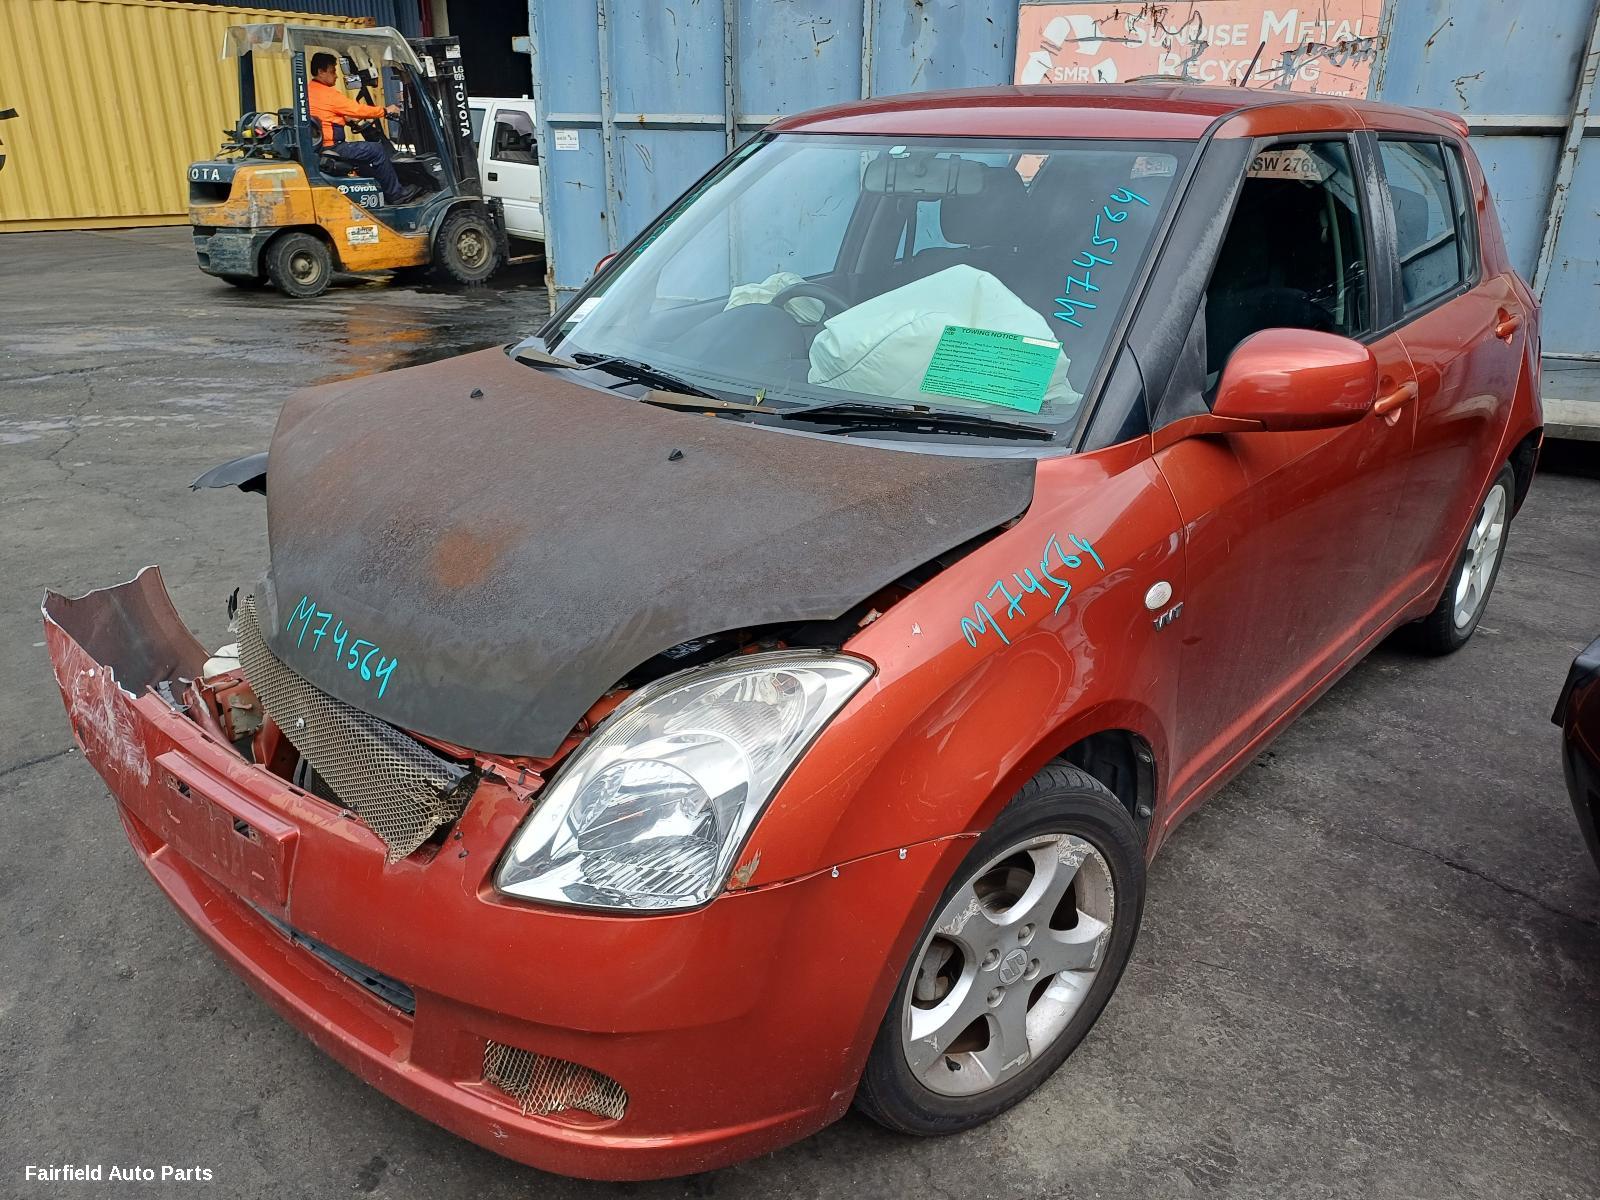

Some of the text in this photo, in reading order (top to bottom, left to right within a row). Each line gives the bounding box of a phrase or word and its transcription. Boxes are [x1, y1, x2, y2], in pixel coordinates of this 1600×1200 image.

[1122, 8, 1370, 48] SUNRISE METAL
[1054, 67, 1090, 82] SMR
[298, 77, 307, 122] LIFTEK
[454, 82, 471, 137] TOYOTA
[1249, 157, 1279, 172] SW
[349, 185, 378, 193] TOYOTA
[360, 194, 378, 208] 30
[1053, 187, 1151, 328] M74564
[962, 328, 991, 337] TOWING
[991, 331, 1019, 341] NOTICE
[960, 532, 1105, 648] M74564
[286, 596, 399, 699] M74564
